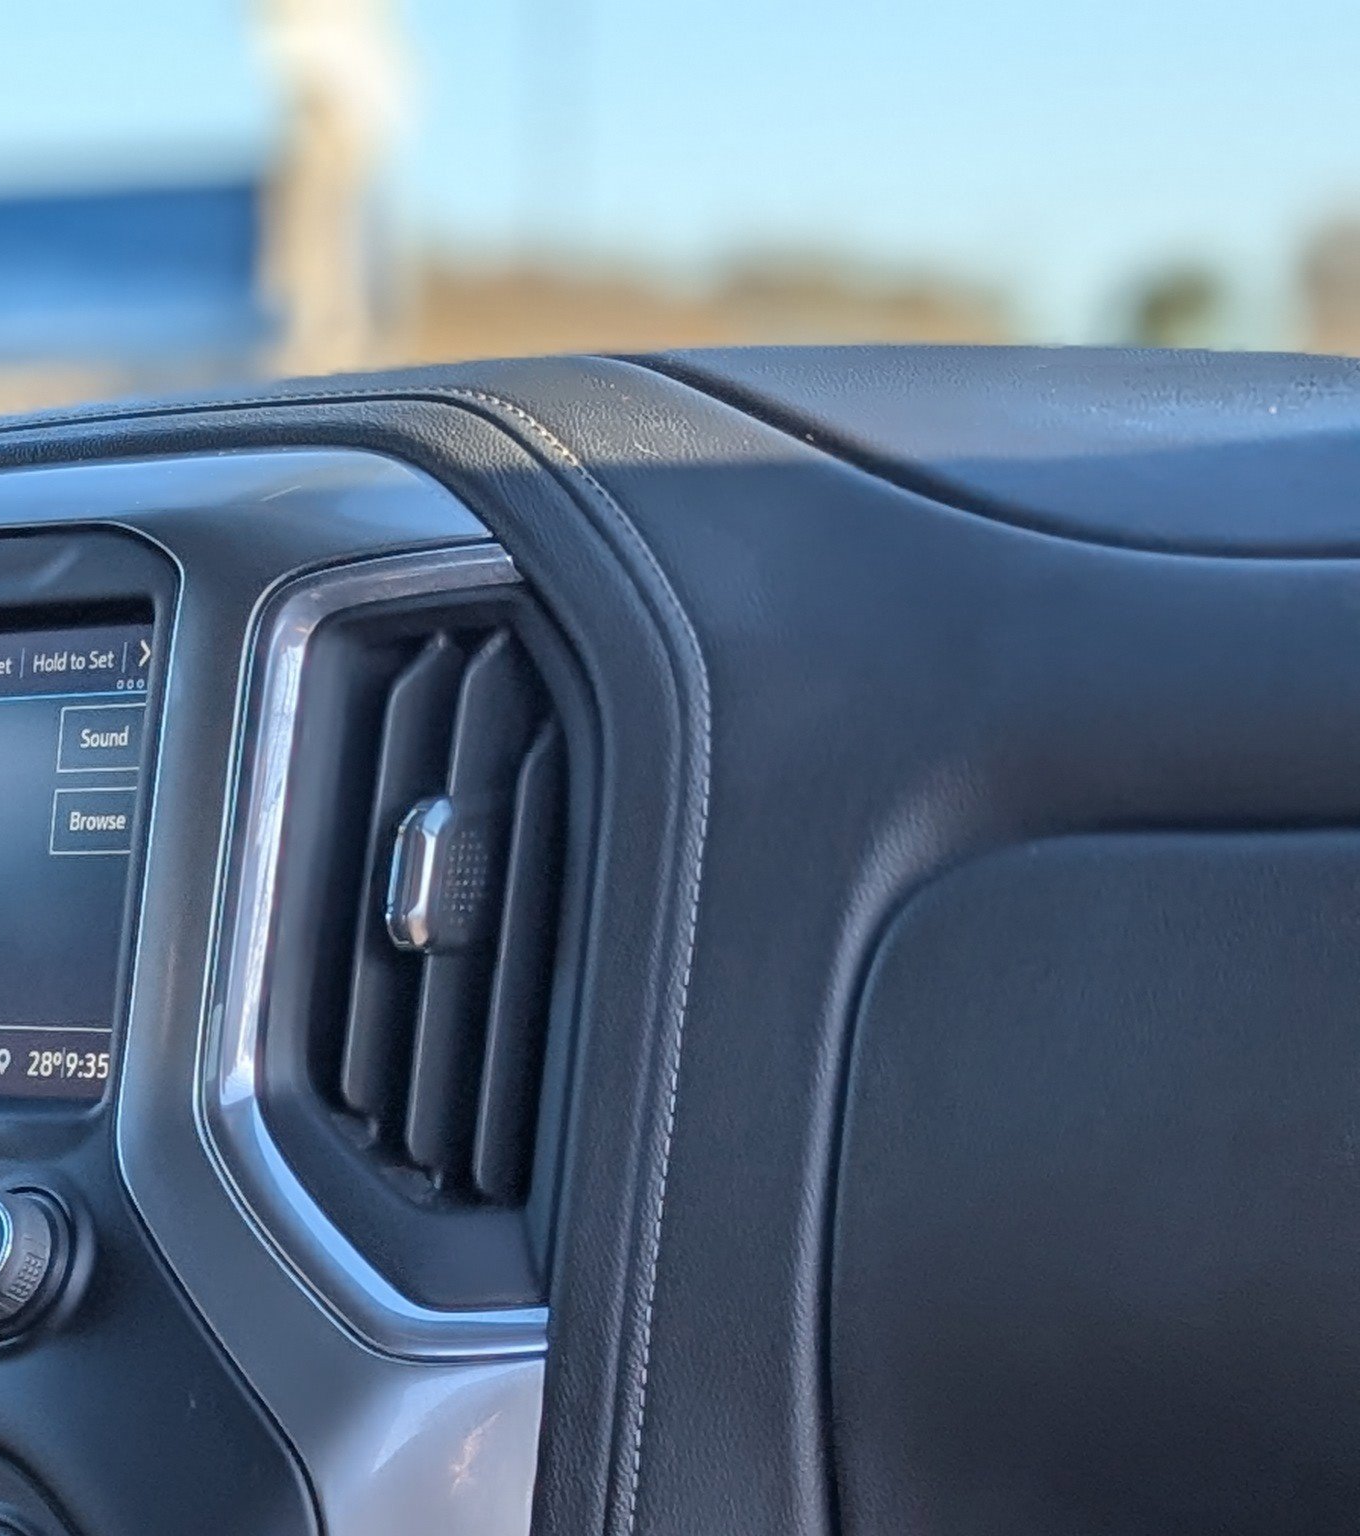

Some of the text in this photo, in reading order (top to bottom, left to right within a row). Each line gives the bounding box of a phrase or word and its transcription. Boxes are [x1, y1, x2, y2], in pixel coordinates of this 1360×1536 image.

[32, 650, 115, 673] Hold to Set
[80, 725, 130, 749] Sound
[69, 811, 127, 831] Browse
[65, 1052, 111, 1079] 9:35
